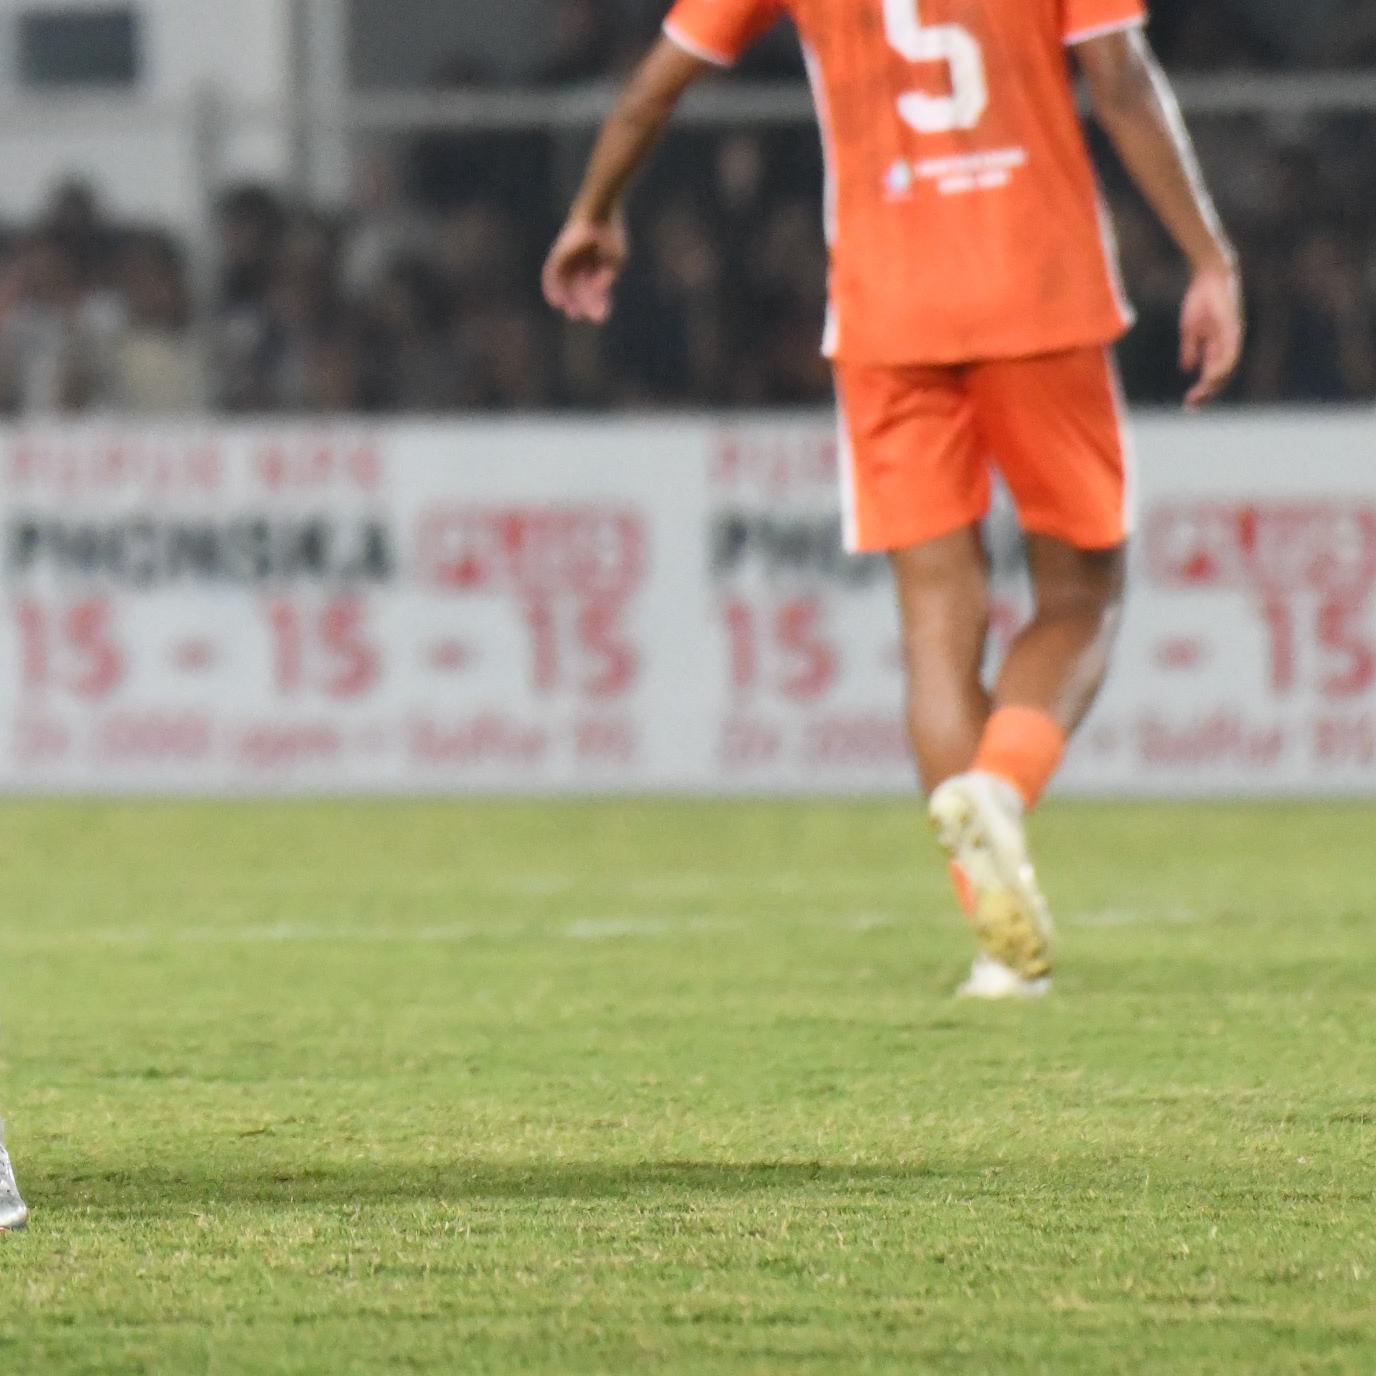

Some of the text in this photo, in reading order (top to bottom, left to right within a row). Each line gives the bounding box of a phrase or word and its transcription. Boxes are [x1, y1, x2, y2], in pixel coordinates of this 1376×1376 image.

[14, 598, 126, 700] 15
[267, 598, 382, 699] 15
[525, 598, 640, 698] 15
[722, 596, 840, 699] 15
